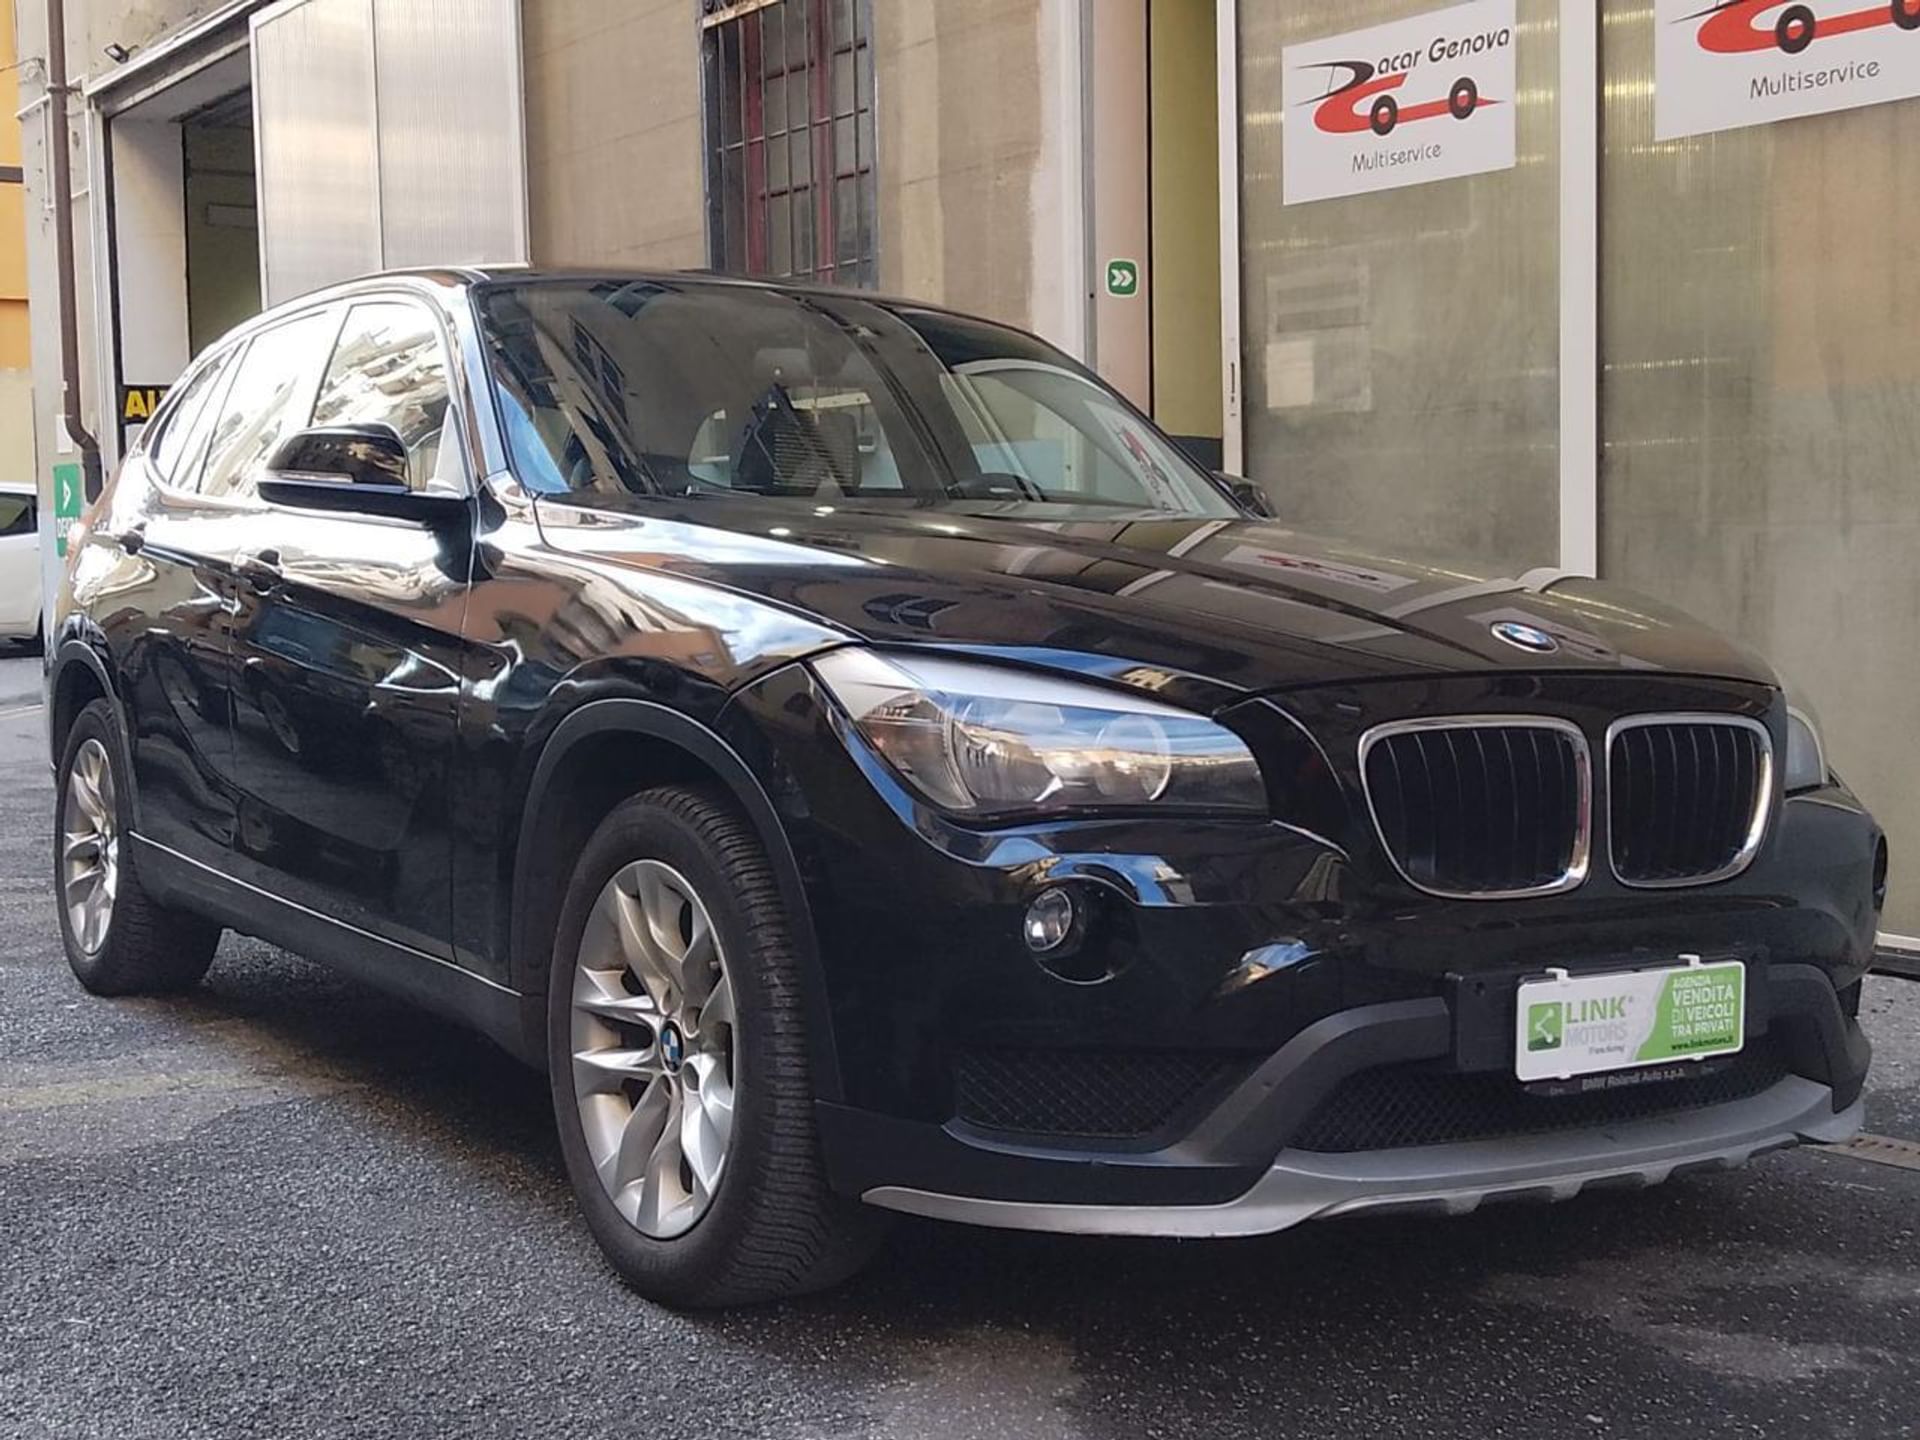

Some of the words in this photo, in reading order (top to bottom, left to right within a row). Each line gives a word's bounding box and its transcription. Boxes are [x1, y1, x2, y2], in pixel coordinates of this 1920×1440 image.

[1428, 28, 1510, 62] Genova
[1750, 60, 1881, 99] Multiservice
[1352, 143, 1442, 172] Multiservice
[1672, 984, 1735, 1007] VENDITA
[1687, 1002, 1735, 1022] VEICOLI
[1565, 1022, 1628, 1049] MOTORS
[1672, 1023, 1692, 1039] TRA
